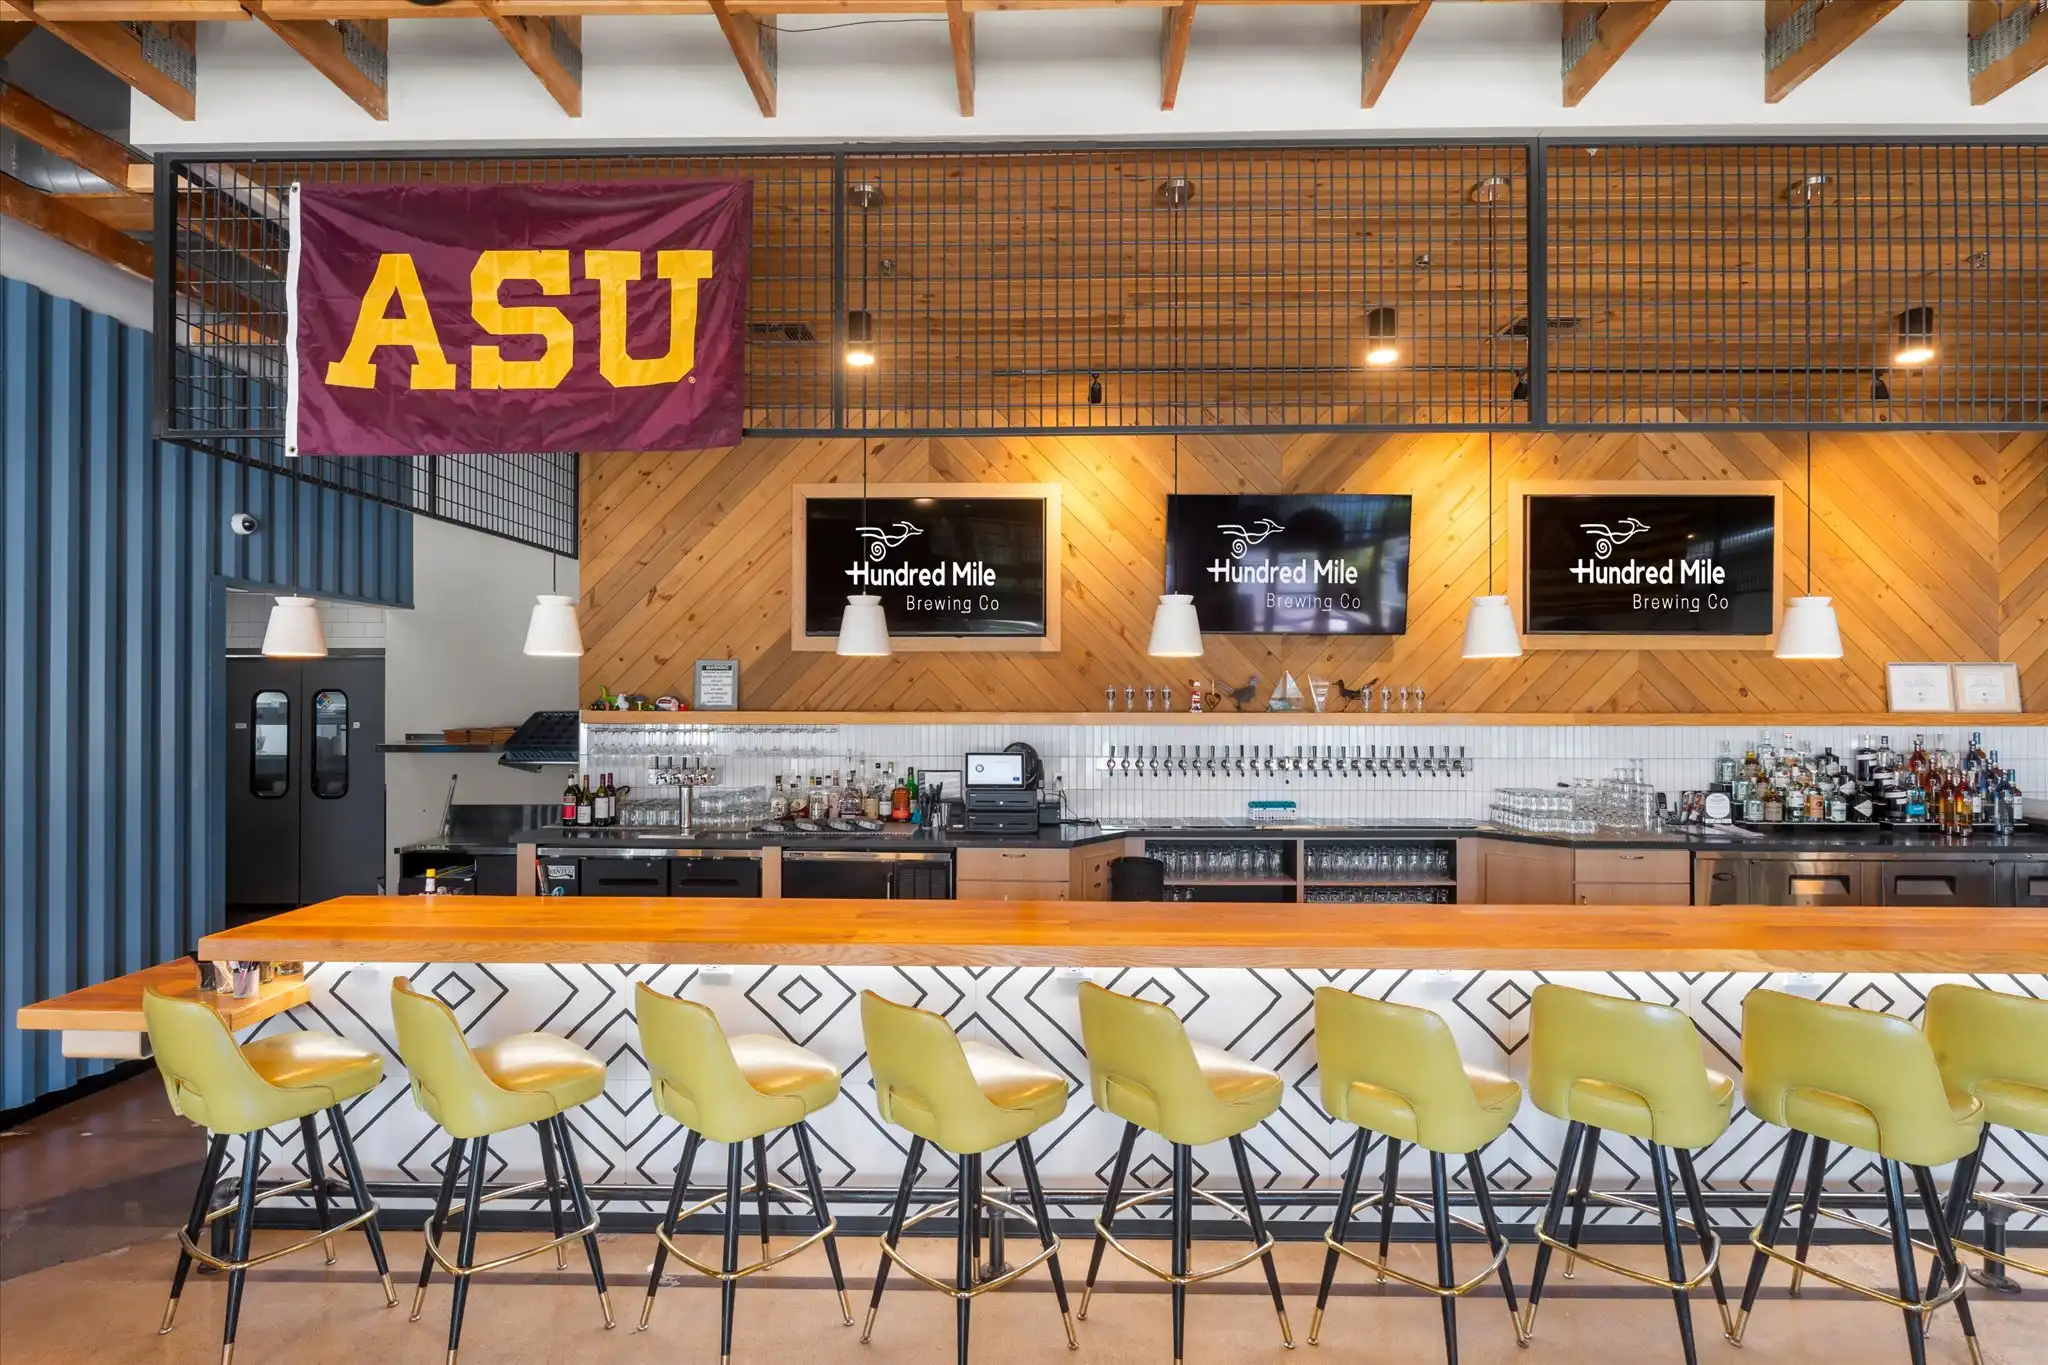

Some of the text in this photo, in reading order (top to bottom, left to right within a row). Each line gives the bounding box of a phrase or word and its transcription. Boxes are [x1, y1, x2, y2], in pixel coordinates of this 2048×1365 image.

[325, 249, 713, 391] ASU
[845, 560, 996, 586] Hundred Mile
[1206, 558, 1358, 585] Hundred Mile
[1569, 558, 1726, 585] Hundred Mile
[906, 594, 999, 614] Brewing Co
[1266, 593, 1361, 612] Brewing Co
[1633, 593, 1729, 613] Brewing Co
